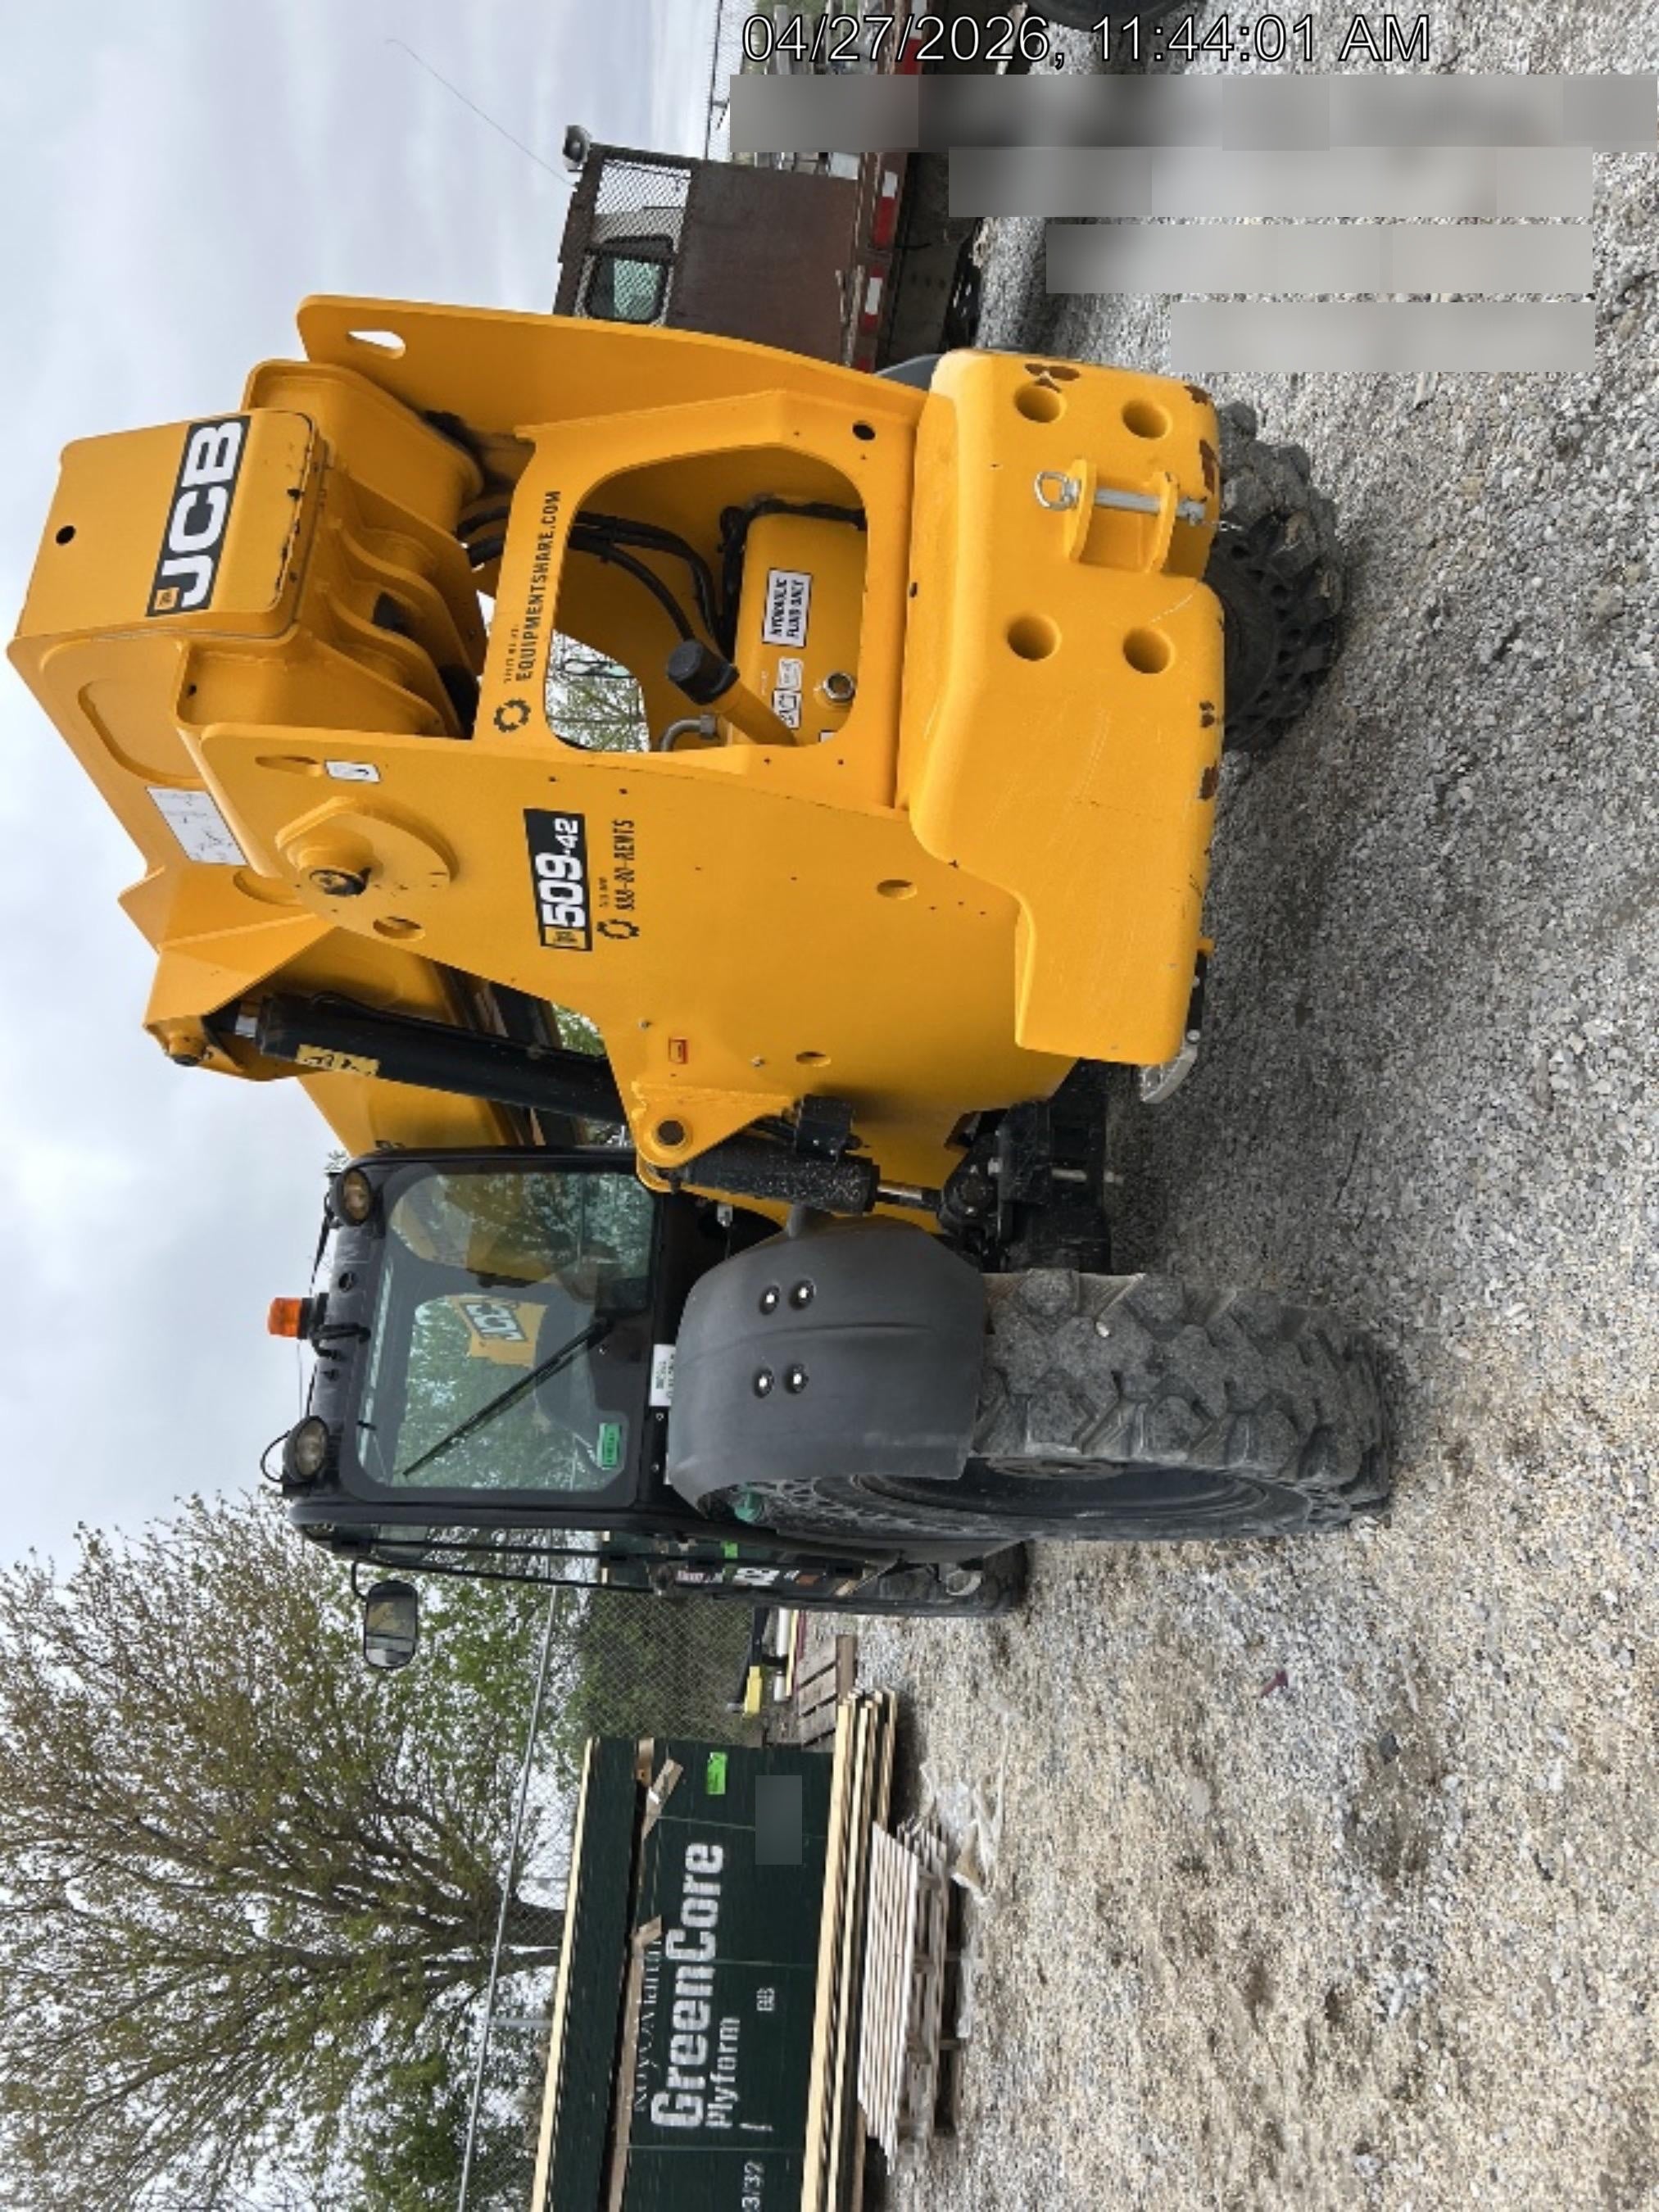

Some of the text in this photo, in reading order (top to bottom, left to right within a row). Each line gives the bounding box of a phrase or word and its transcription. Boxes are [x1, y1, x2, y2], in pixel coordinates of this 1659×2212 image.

[161, 421, 243, 608] JCB
[515, 490, 561, 682] EQUIPMENTSHARE.COM
[465, 1304, 524, 1341] JCB
[650, 1842, 724, 2128] GreenCore
[704, 2016, 741, 2129] Plyform
[741, 2160, 765, 2212] 3/32
